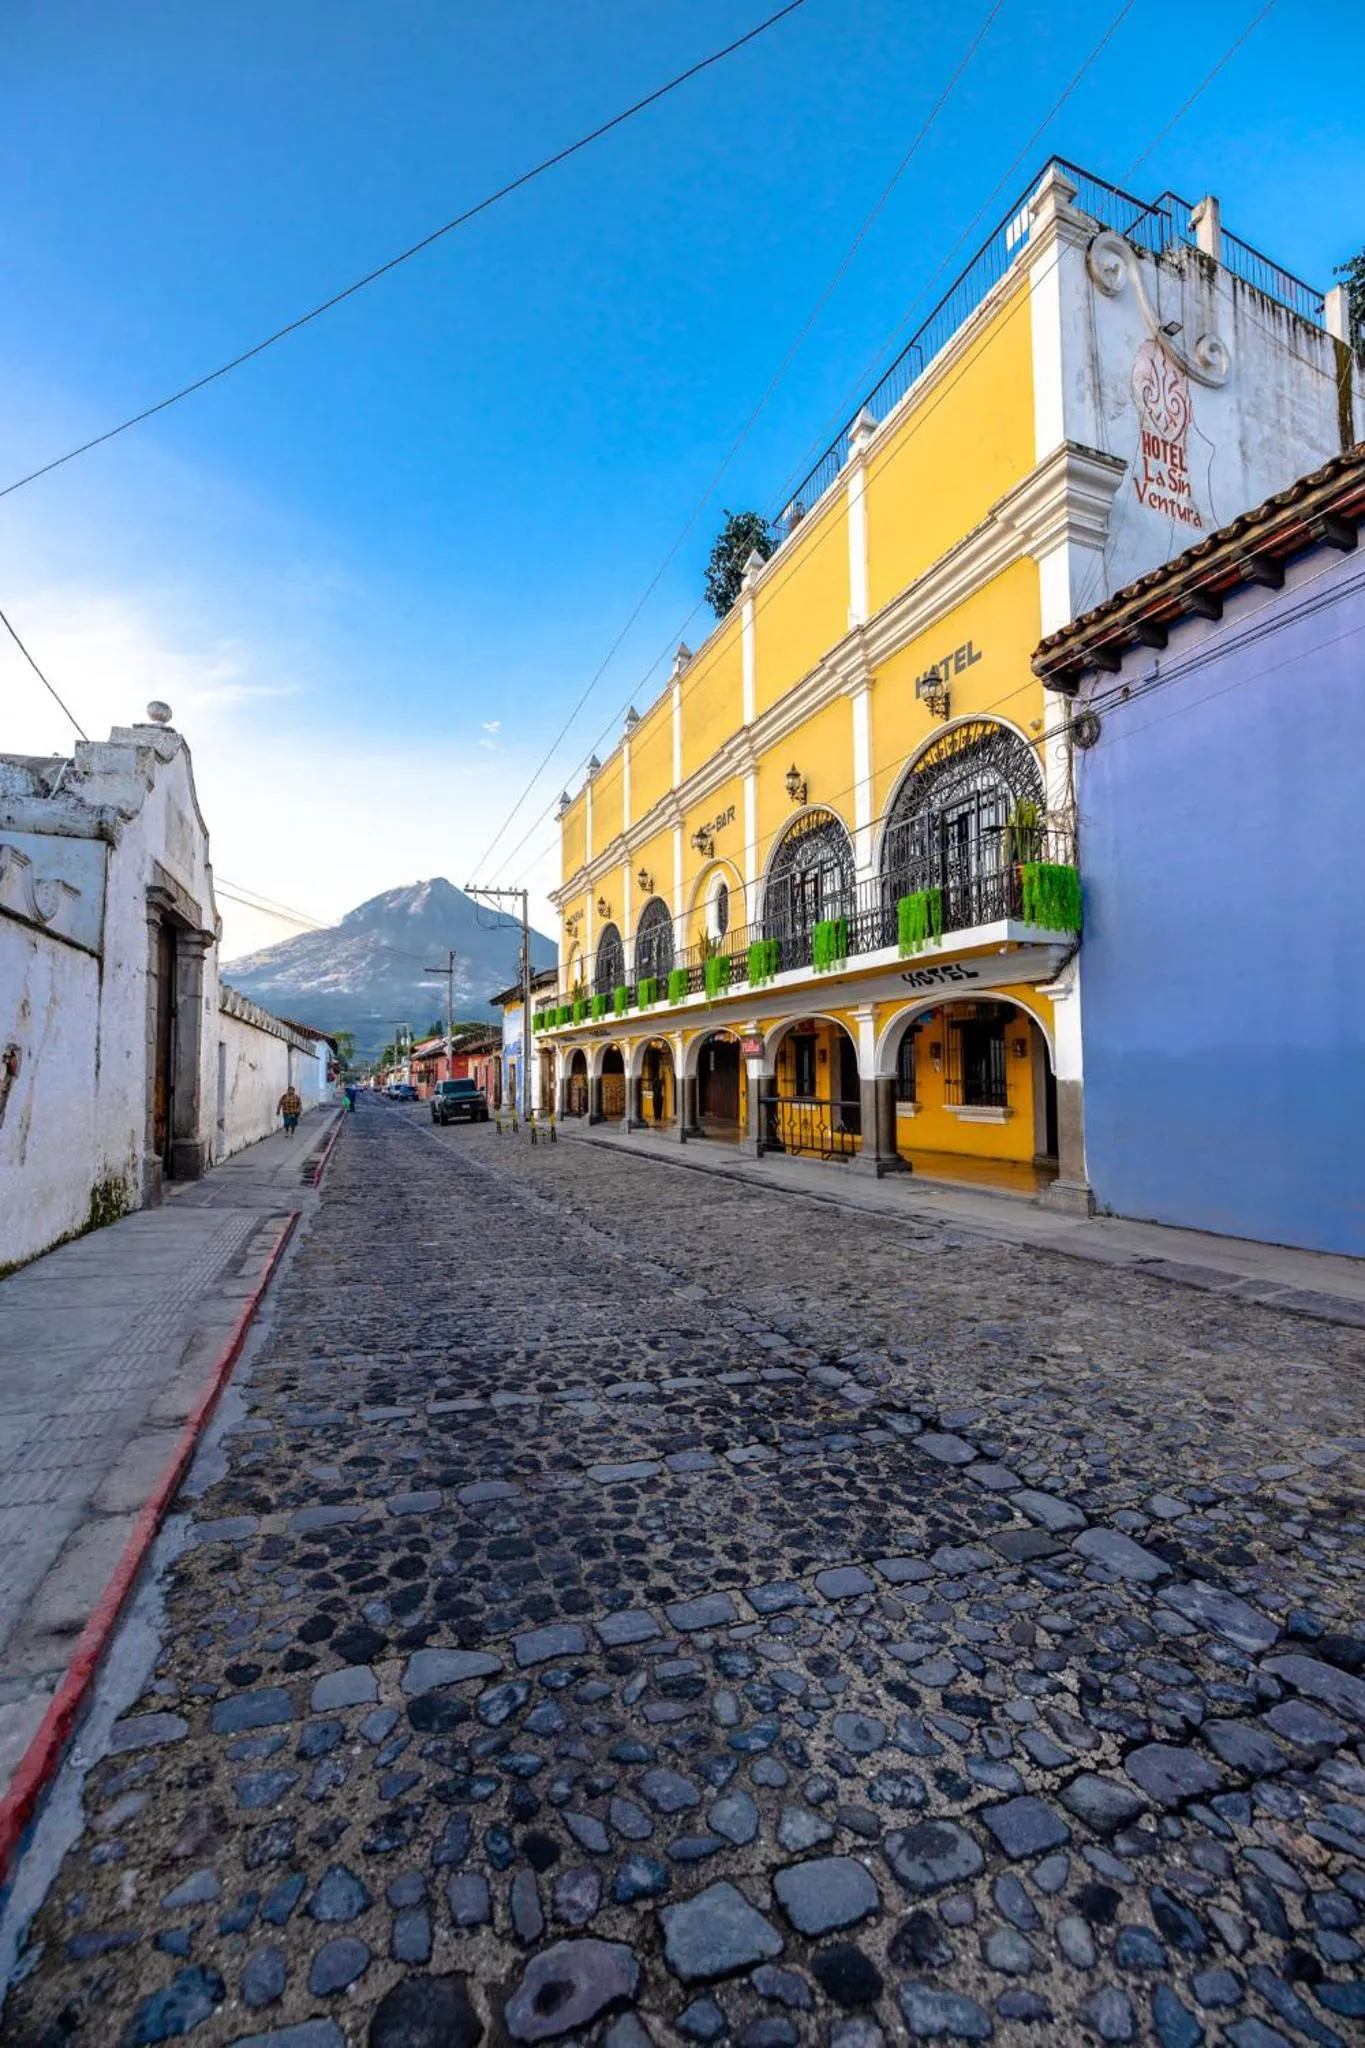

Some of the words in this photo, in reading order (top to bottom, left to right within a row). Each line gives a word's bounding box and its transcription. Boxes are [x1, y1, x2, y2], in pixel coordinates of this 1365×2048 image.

[1142, 430, 1188, 473] HOTEL
[1144, 456, 1166, 488] La
[1167, 468, 1191, 497] Sin
[1133, 477, 1202, 528] Ventura
[915, 640, 982, 700] HTEL
[901, 963, 979, 988] HOTEL
